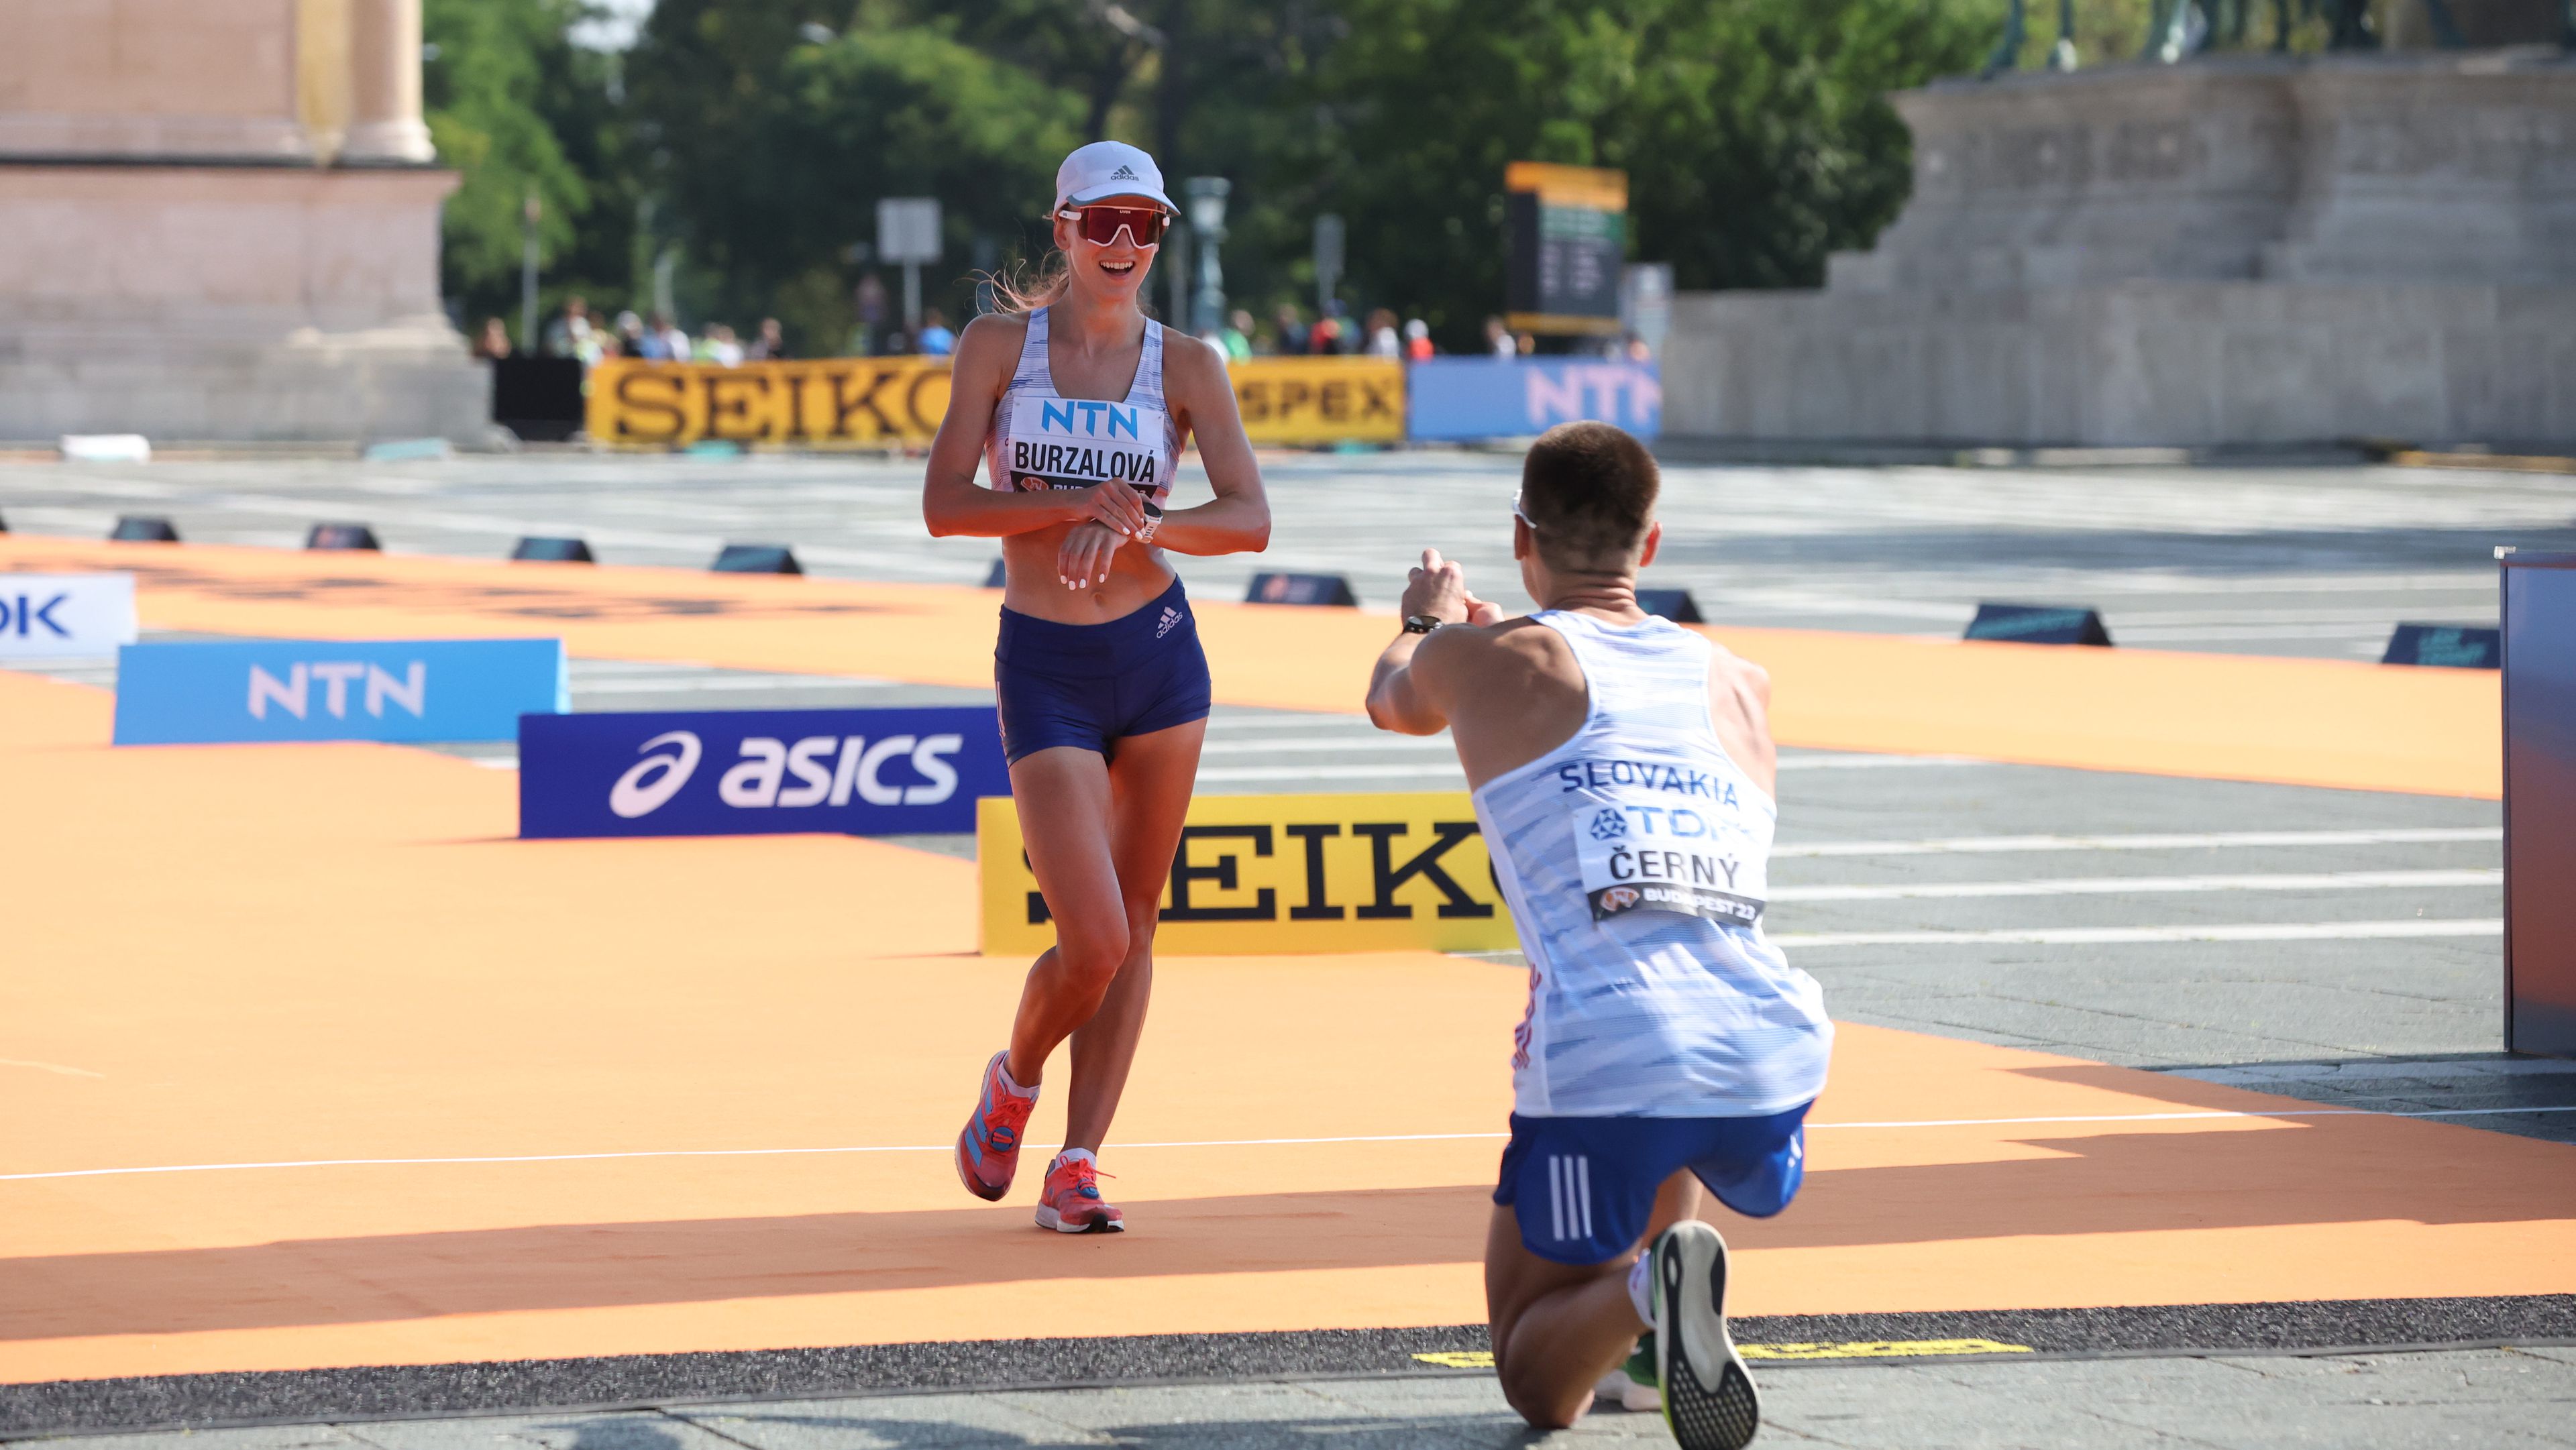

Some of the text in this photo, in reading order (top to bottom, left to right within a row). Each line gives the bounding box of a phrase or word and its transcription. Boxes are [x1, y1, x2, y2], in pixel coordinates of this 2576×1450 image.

[1111, 174, 1139, 182] adidas
[1041, 400, 1138, 441] NTN
[1015, 441, 1155, 482] BURZALOVÁ
[1156, 612, 1183, 639] adidas
[248, 661, 426, 720] NTN
[719, 734, 964, 808] asics
[1560, 760, 1739, 810] SLOVAKIA
[1023, 822, 1509, 923] EIK
[1610, 846, 1740, 888] ČERNÝ
